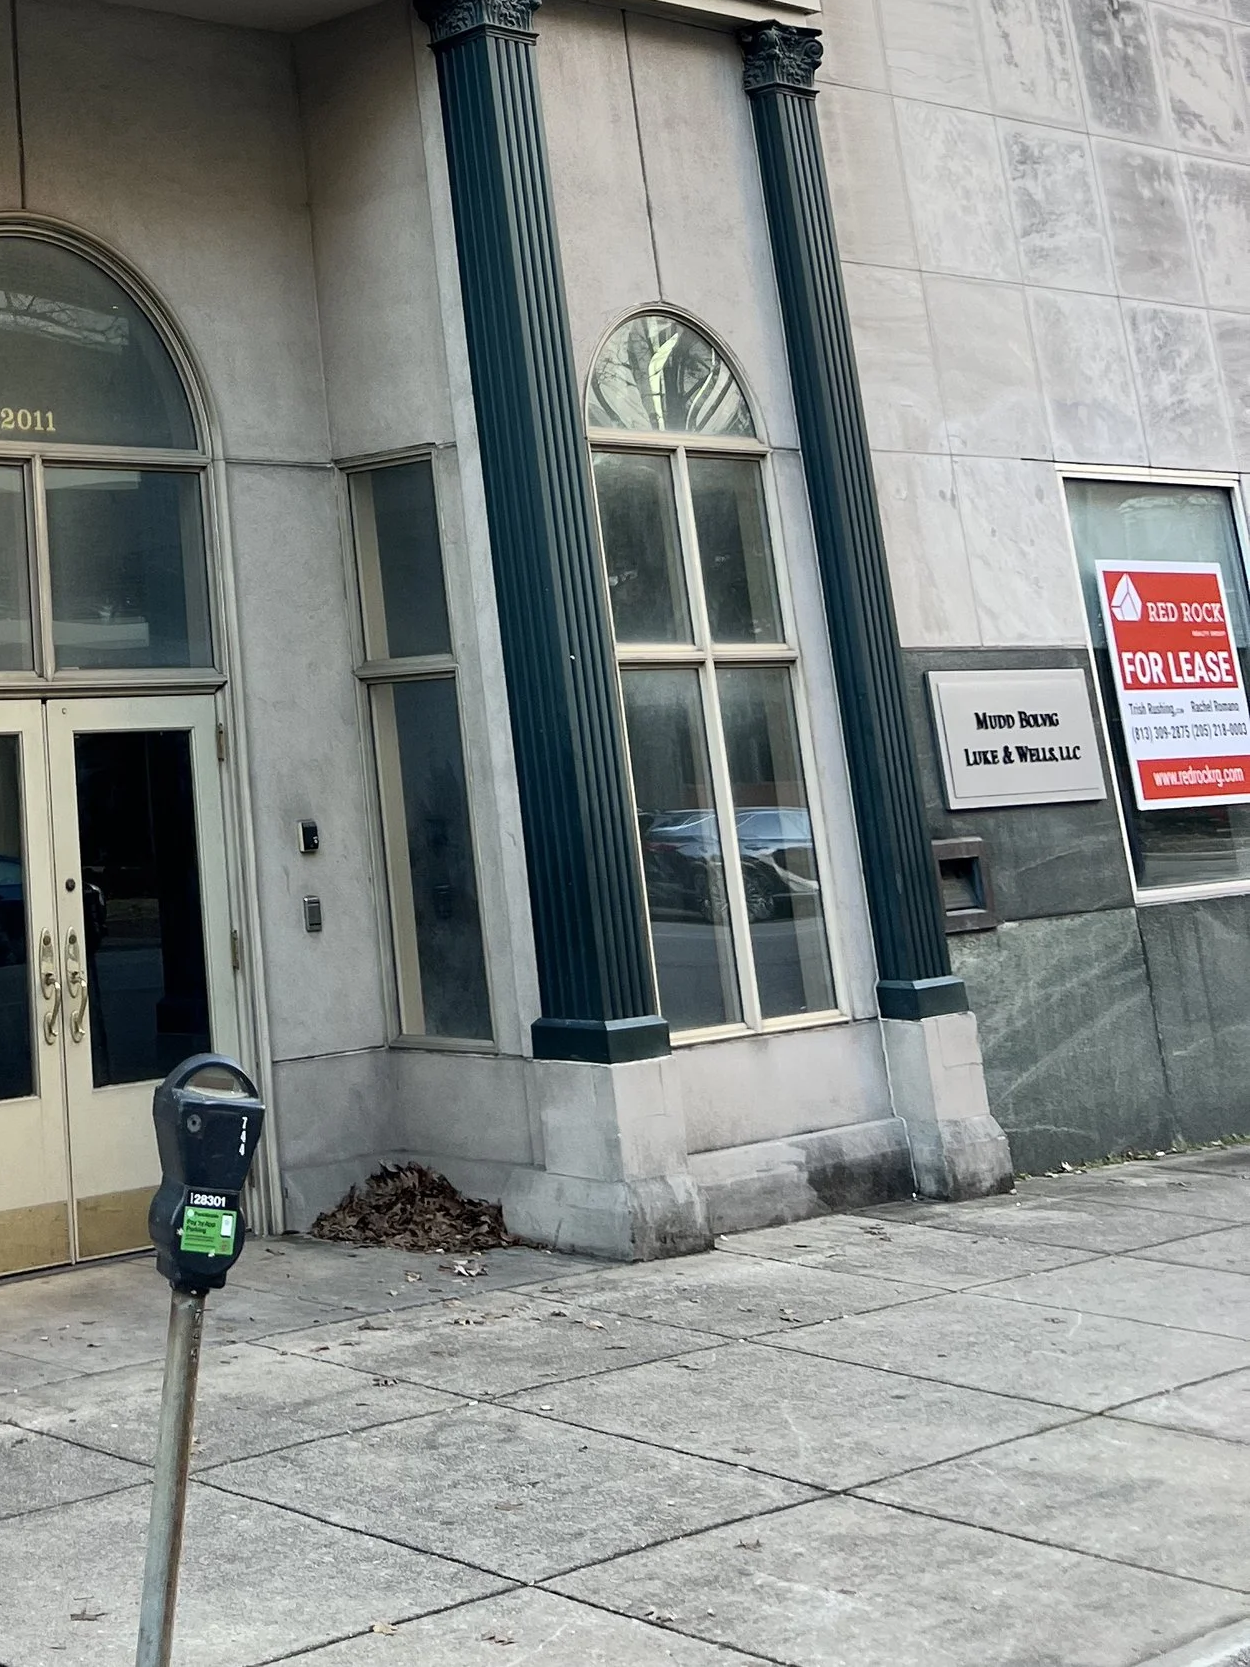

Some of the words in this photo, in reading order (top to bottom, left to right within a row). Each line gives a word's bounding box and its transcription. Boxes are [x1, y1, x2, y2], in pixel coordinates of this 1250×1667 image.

[0, 407, 56, 432] 2011
[1146, 601, 1179, 622] RED
[1180, 601, 1224, 623] ROCK
[1122, 650, 1167, 684] FOR
[1167, 650, 1234, 683] LEASE
[1132, 725, 1153, 744] (813)
[1153, 724, 1190, 740] 309-2875
[1191, 722, 1212, 740] (205)
[1002, 745, 1014, 765] &
[1058, 745, 1081, 761] LLC
[1152, 764, 1245, 788] www.redrockrg.com
[193, 1193, 226, 1207] 28301
